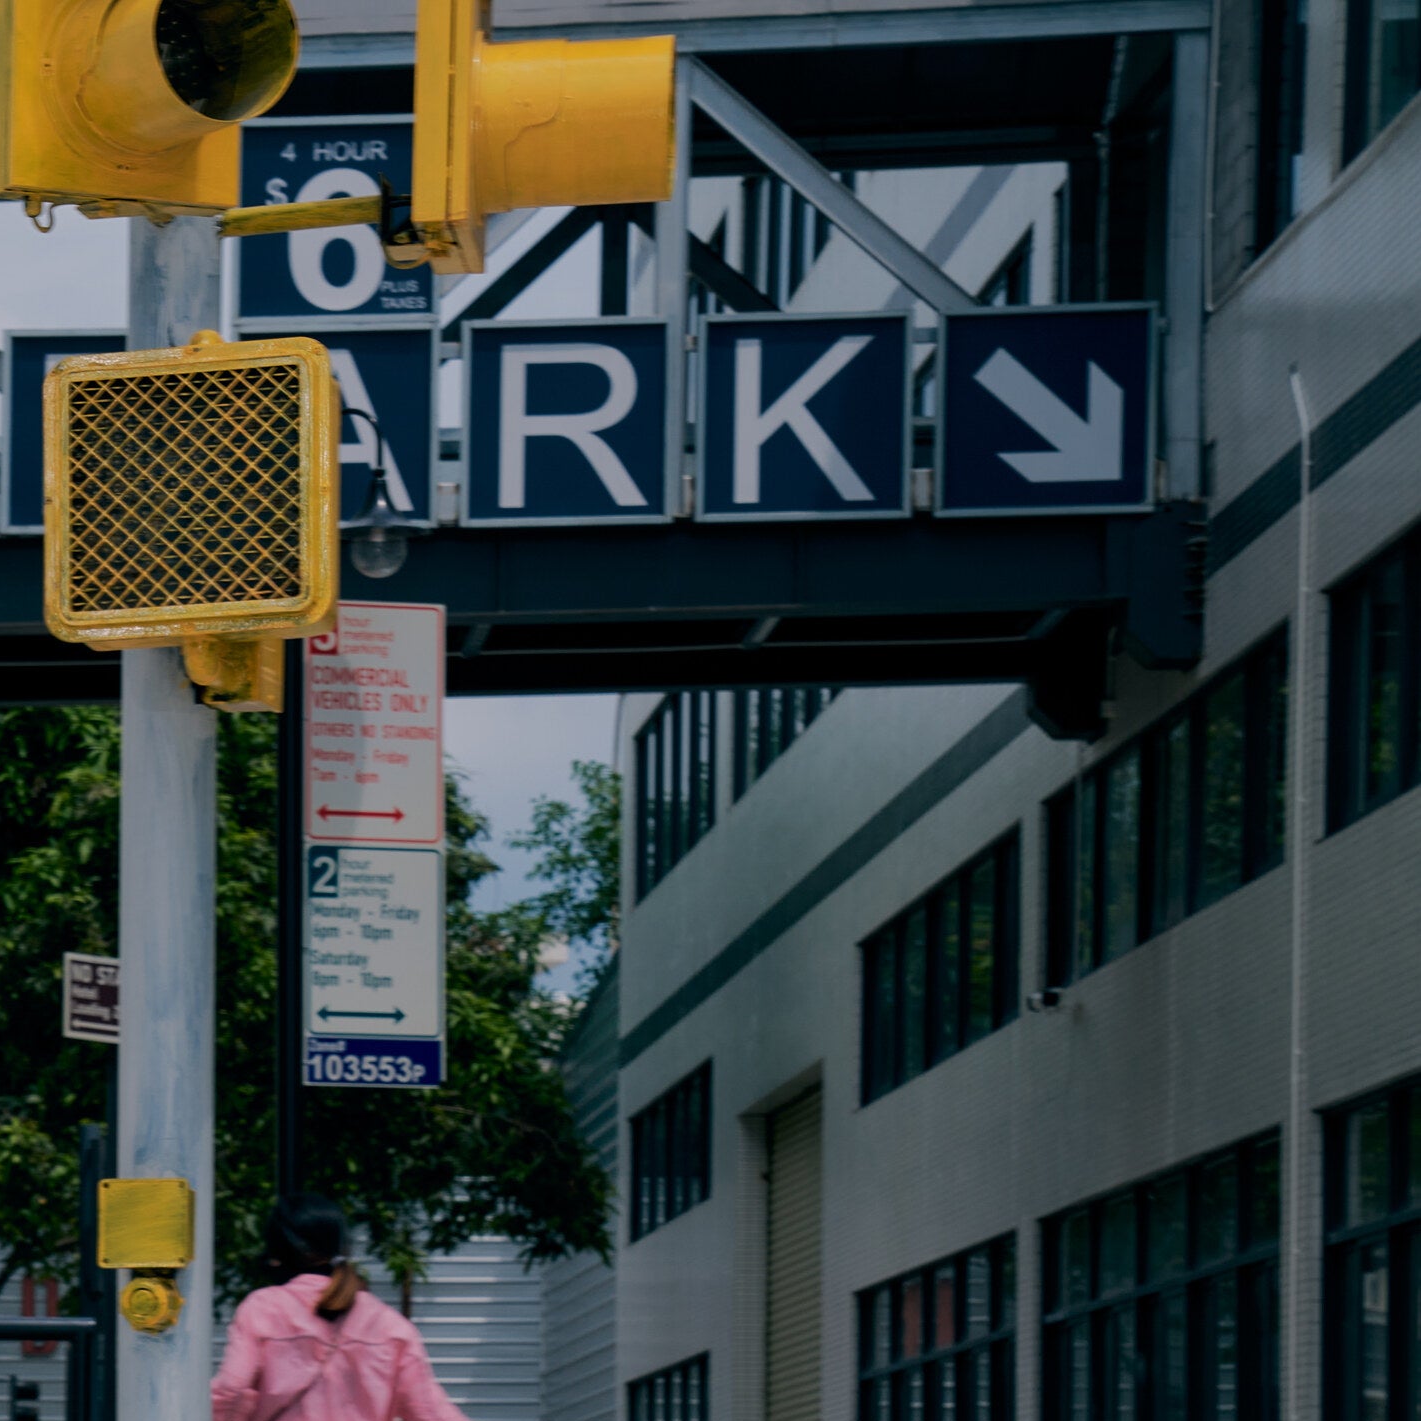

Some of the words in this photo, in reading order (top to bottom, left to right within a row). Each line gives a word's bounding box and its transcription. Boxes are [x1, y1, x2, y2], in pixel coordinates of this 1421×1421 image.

[279, 142, 297, 162] 4
[312, 140, 389, 162] HOUR
[380, 279, 419, 293] PLUS
[380, 296, 428, 310] TAXES
[44, 336, 875, 511] ARK
[311, 665, 410, 688] COMMERCIAL
[311, 690, 383, 712] VEHICLES
[389, 694, 428, 713] ONLY
[312, 856, 336, 894] 2
[310, 903, 361, 921] Monday
[379, 903, 421, 923] Friday
[309, 950, 370, 968] Saturday
